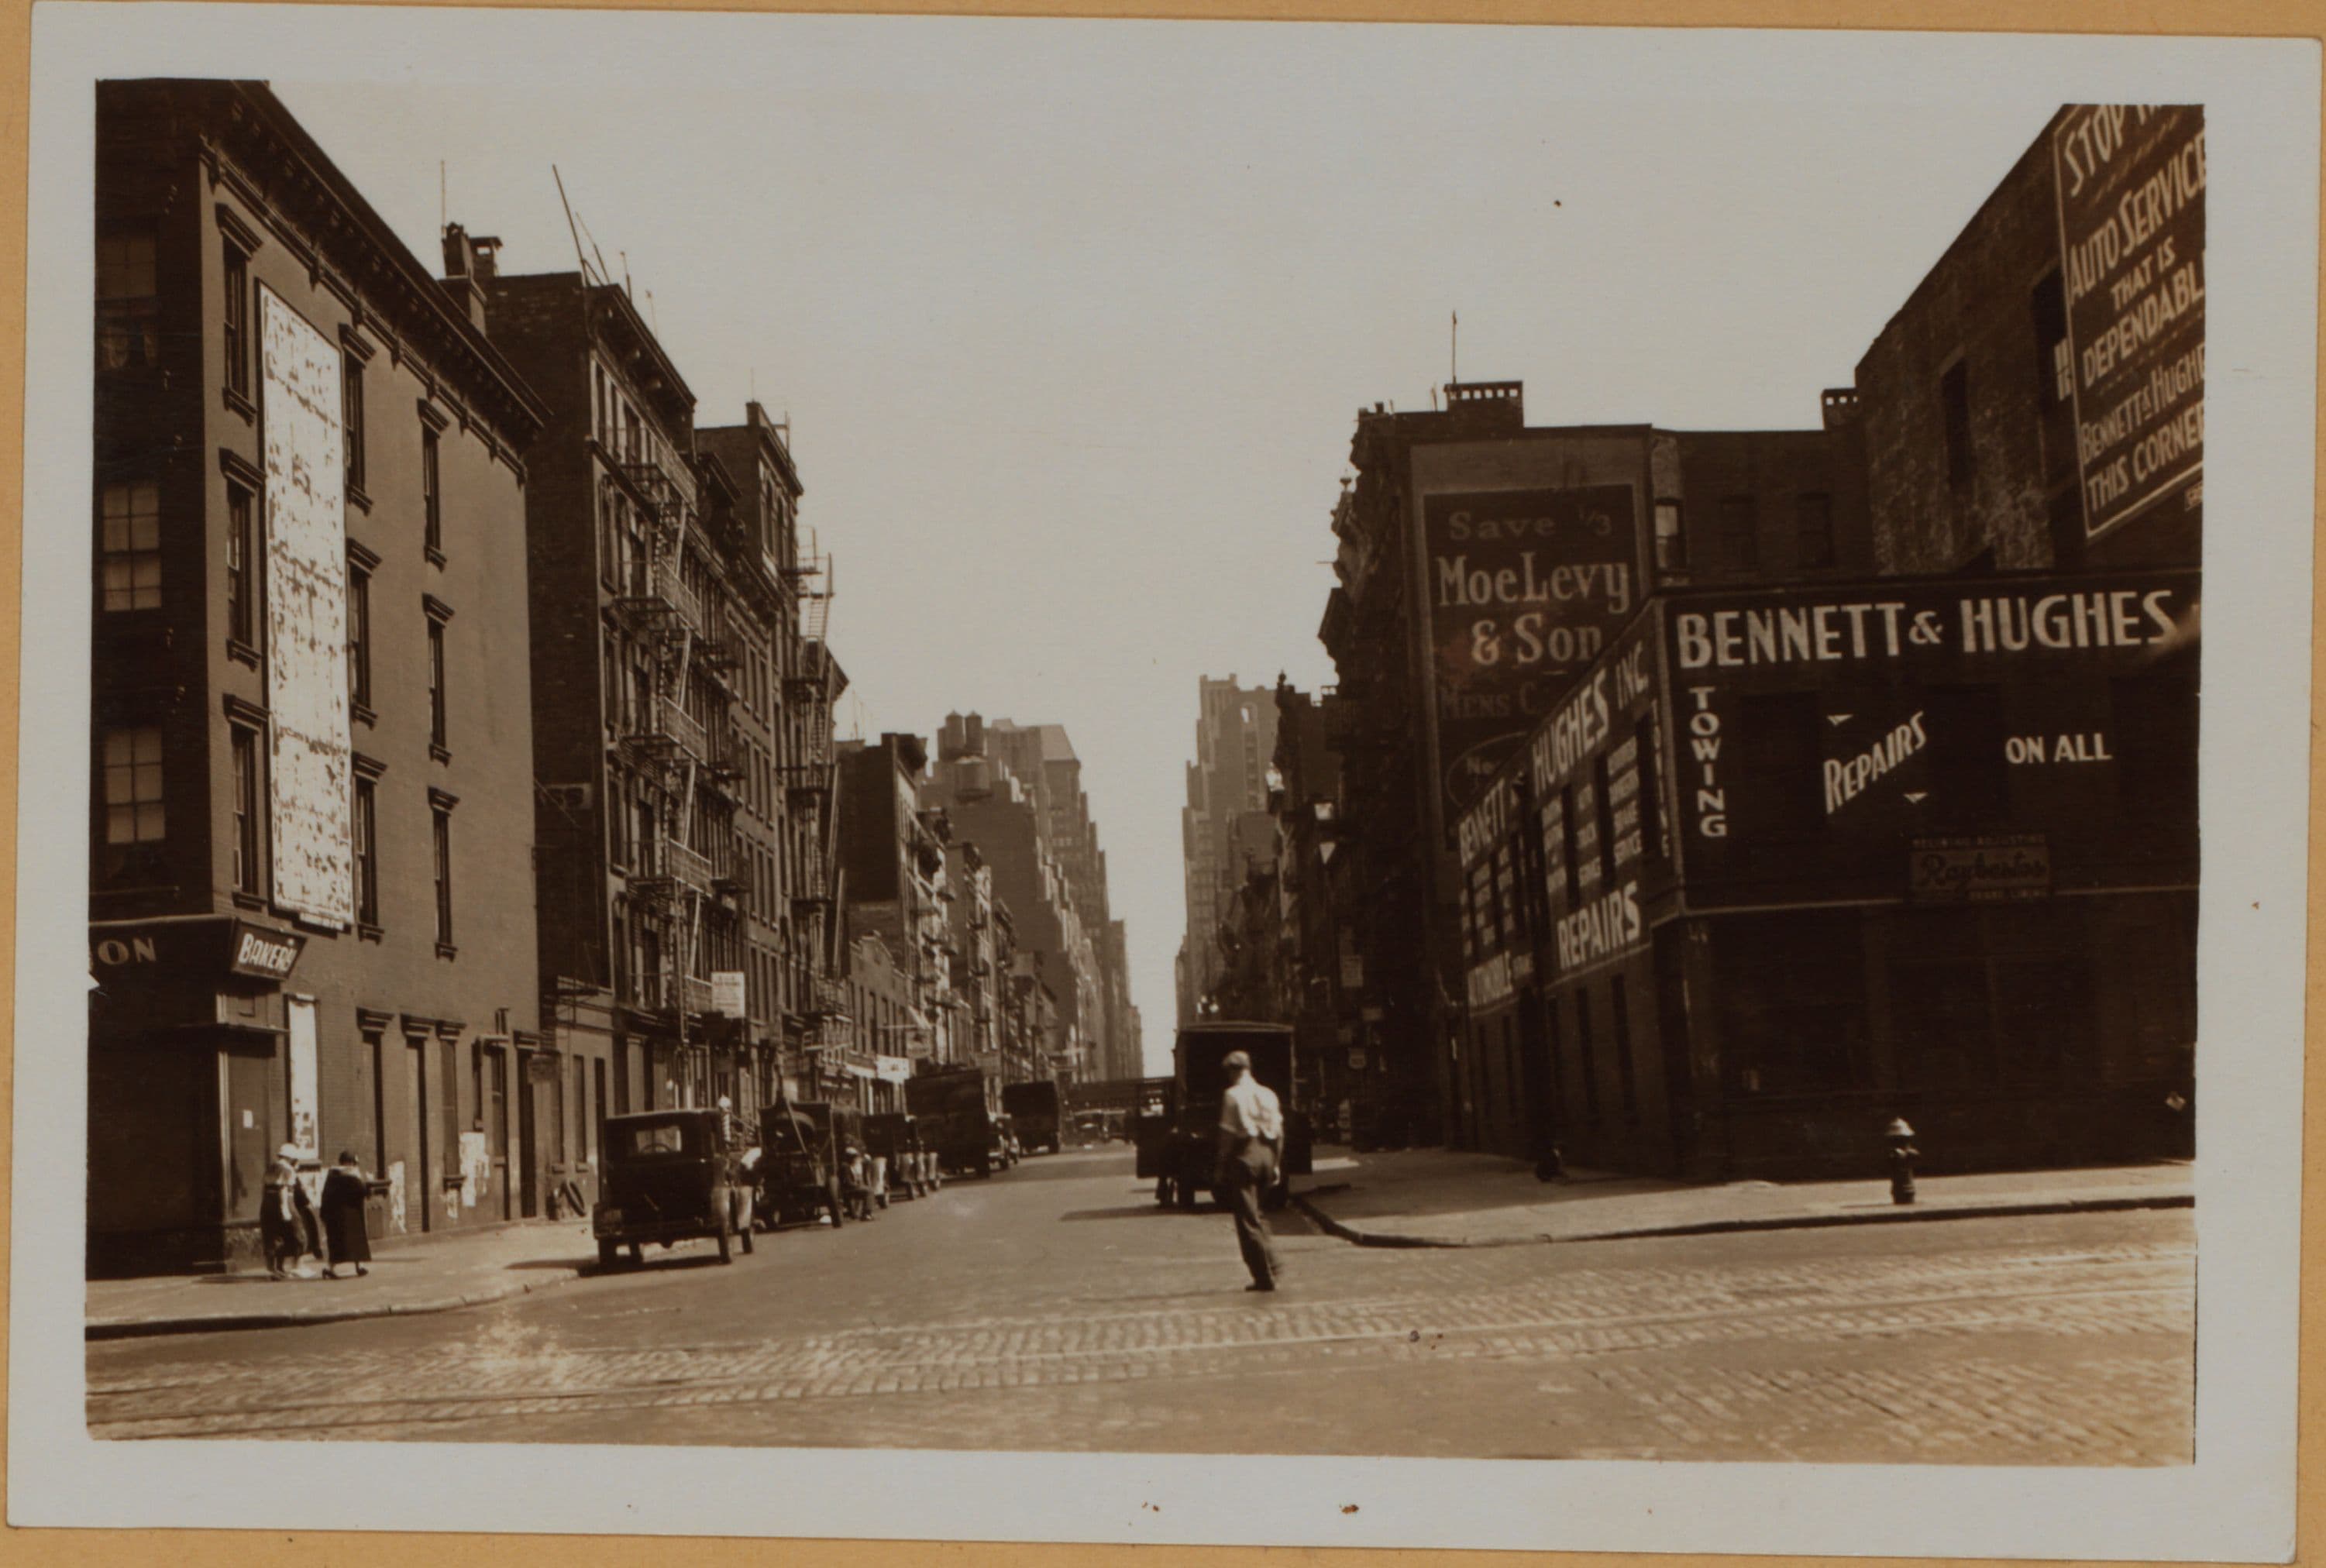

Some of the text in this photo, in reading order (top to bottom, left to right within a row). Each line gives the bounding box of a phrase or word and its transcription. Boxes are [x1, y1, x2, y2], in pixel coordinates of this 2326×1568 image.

[2065, 105, 2125, 198] STOP
[2069, 218, 2120, 305] AUTO
[2111, 236, 2176, 311] THAT IS
[2082, 249, 2206, 388] DEPENDABL
[2079, 389, 2143, 466] BENNETT
[2087, 455, 2129, 513] THIS
[1448, 511, 1557, 541] Save
[1471, 612, 1603, 668] & Son
[1676, 590, 2179, 669] BENNETT & HUGHES
[1458, 776, 1506, 867] BENNETT
[1532, 666, 1610, 799] HUGHES
[1688, 686, 1728, 838] TOWING
[1823, 710, 1927, 814] REPAIRS
[2004, 732, 2114, 765] ON ALL
[88, 938, 157, 965] ON
[238, 932, 297, 972] BAKERY
[1557, 879, 1642, 970] REPAIRS
